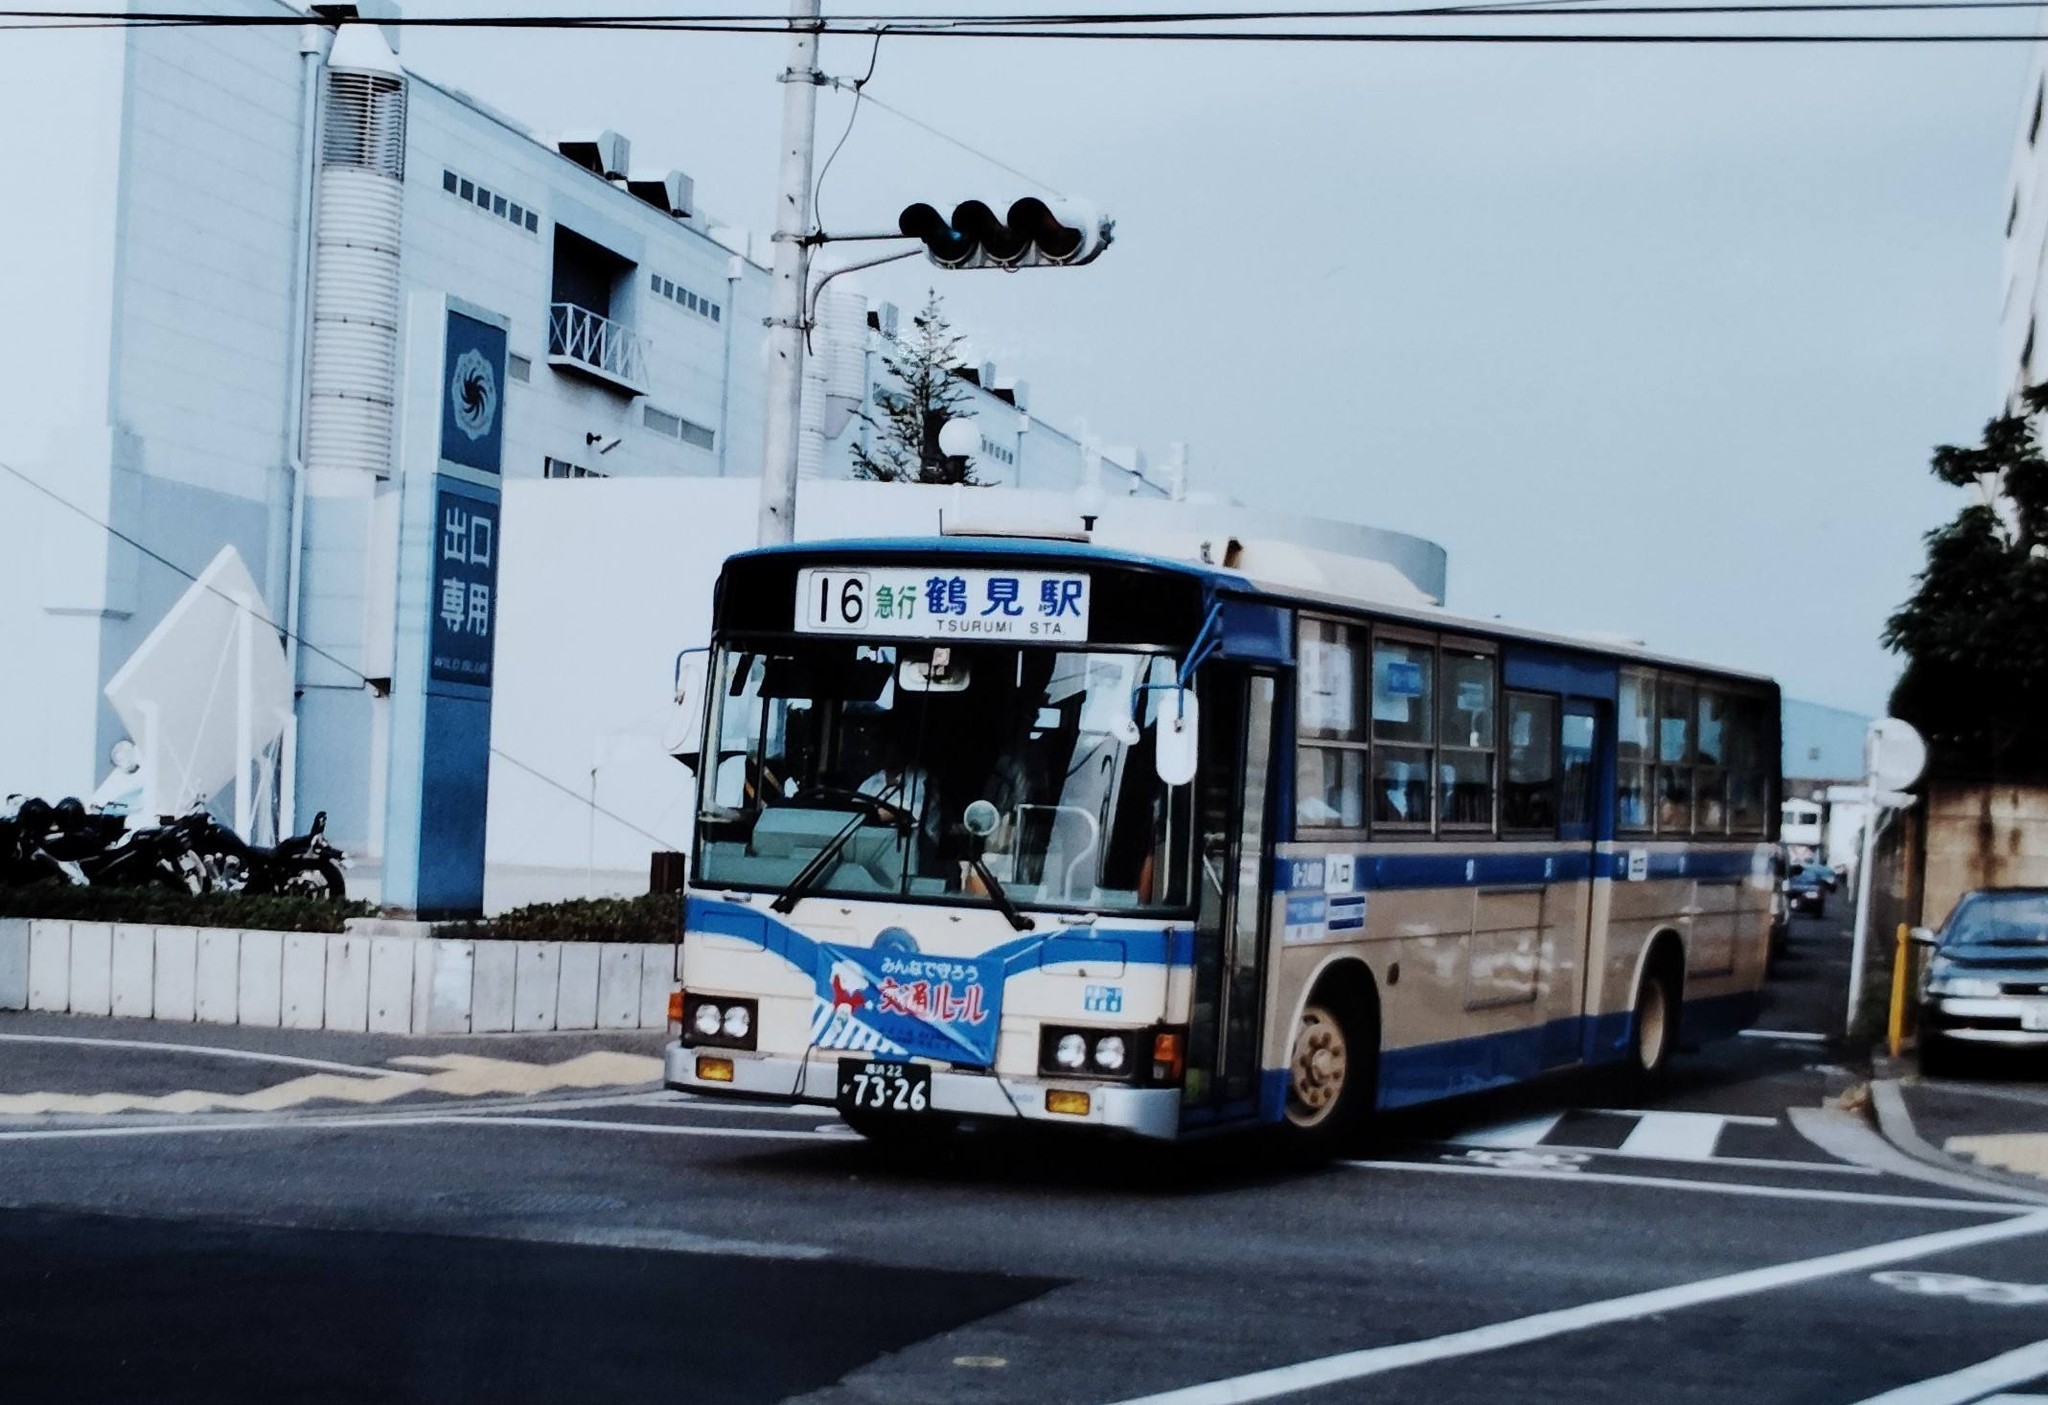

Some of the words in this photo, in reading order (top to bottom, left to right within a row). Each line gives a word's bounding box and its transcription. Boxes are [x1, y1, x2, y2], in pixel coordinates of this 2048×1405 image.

[444, 507, 491, 567] 出口
[441, 577, 489, 636] 専用
[820, 577, 863, 623] 16
[874, 584, 917, 620] 急行
[924, 576, 1082, 617] 鶴見駅
[936, 619, 1013, 633] TSURUMI
[881, 957, 979, 983] みんなで守ろう
[877, 976, 990, 1026] 交通ルール
